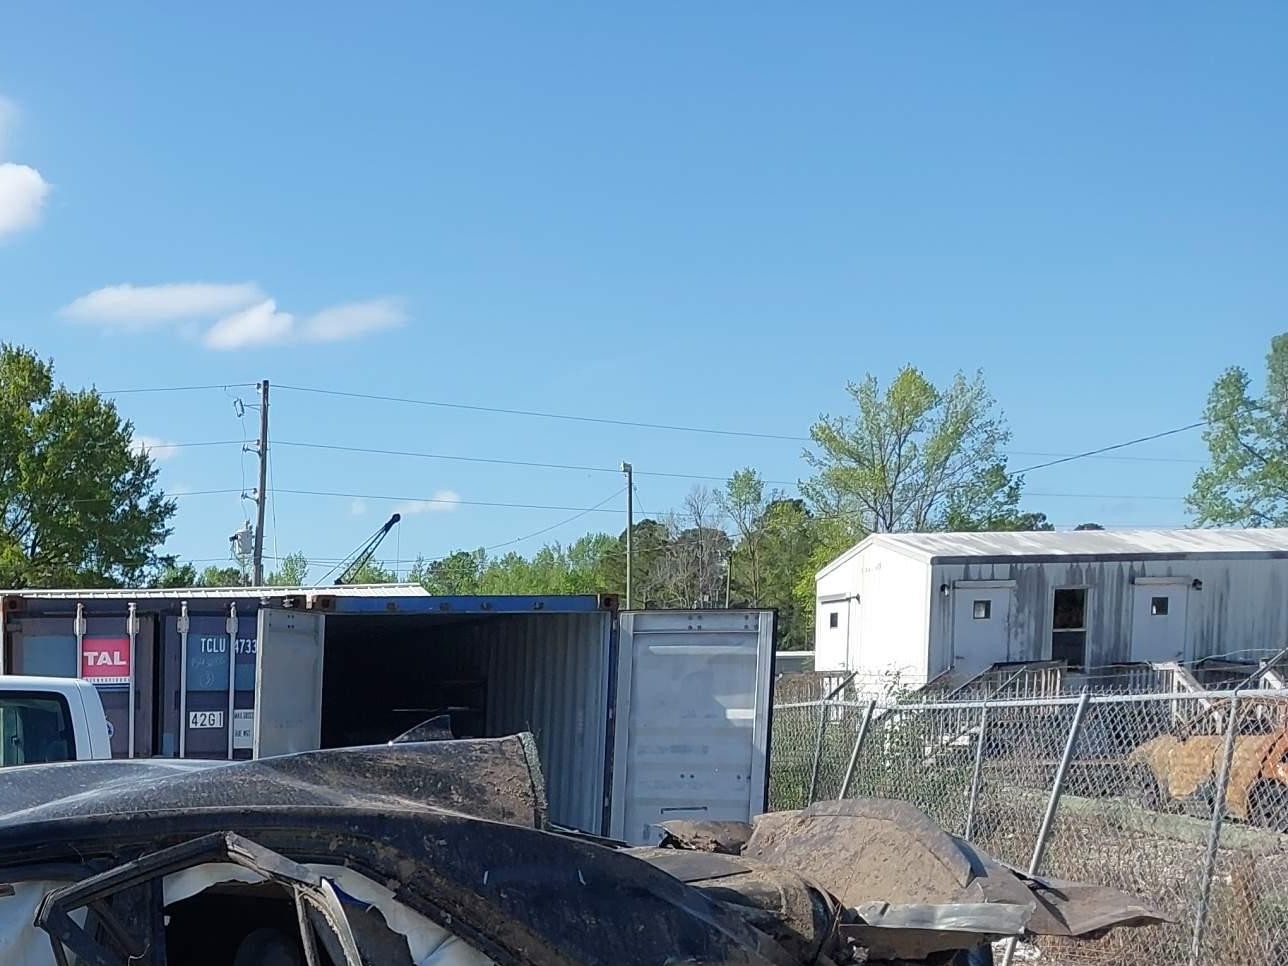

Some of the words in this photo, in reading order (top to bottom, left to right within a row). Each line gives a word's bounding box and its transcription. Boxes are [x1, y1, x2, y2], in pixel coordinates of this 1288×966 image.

[200, 638, 226, 653] TCLU
[83, 651, 128, 666] TAL
[192, 713, 222, 727] 42G1
